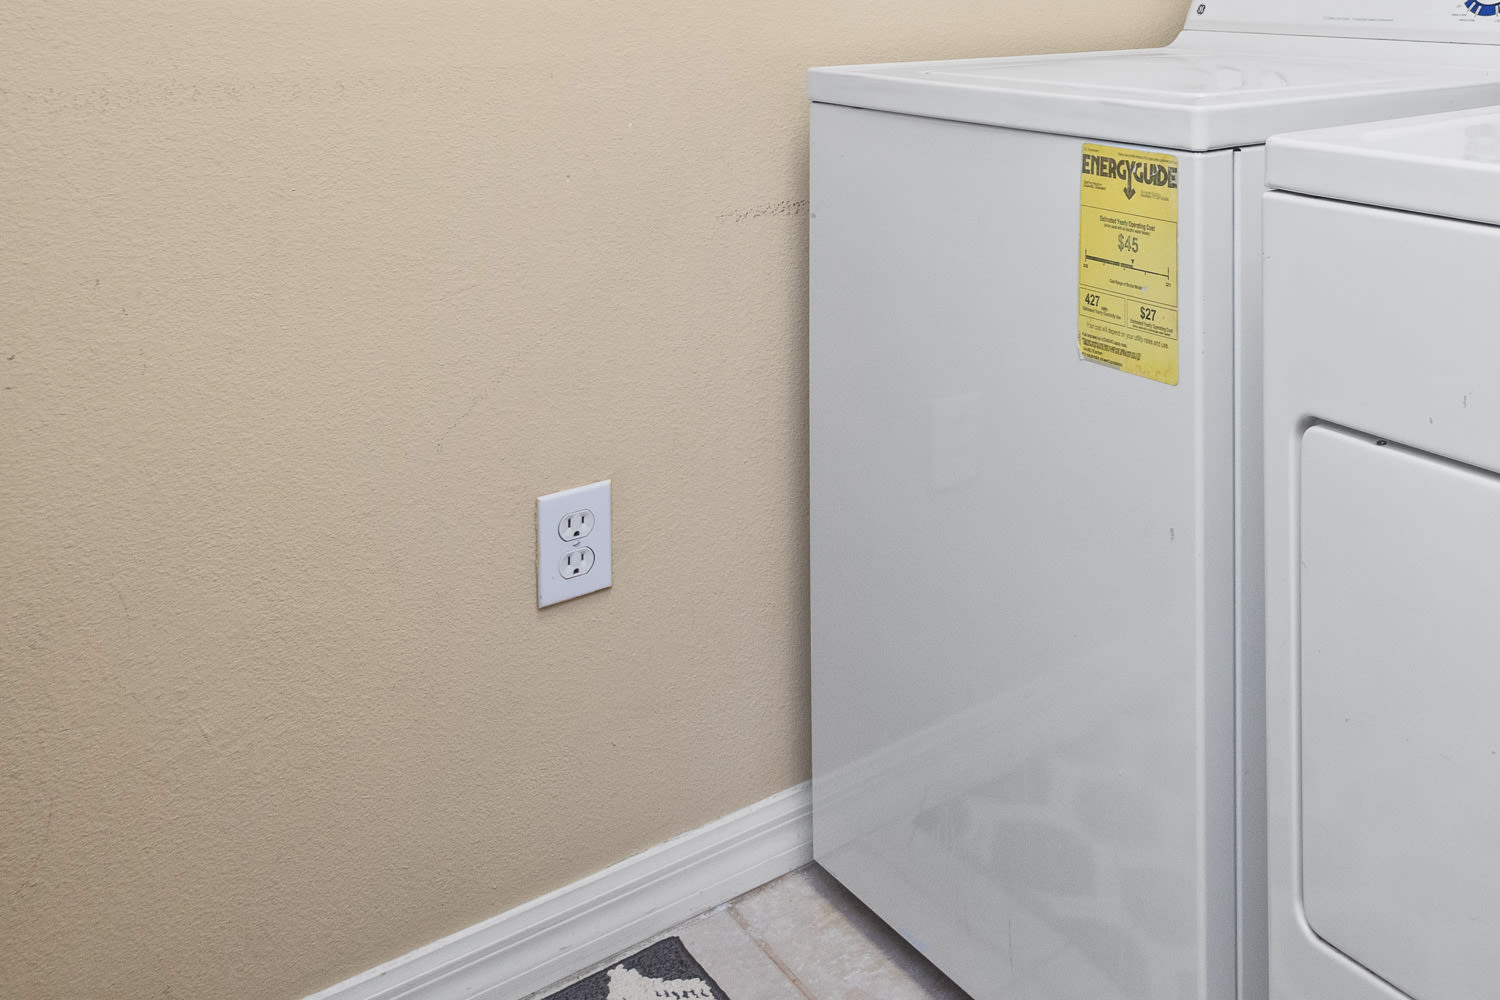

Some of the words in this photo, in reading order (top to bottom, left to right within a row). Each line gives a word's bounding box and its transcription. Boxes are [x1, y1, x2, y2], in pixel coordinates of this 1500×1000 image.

[1082, 153, 1178, 190] ENERGYGUIDE
[1118, 233, 1139, 254] $45
[1085, 293, 1100, 307] 427
[1140, 306, 1157, 321] $27
